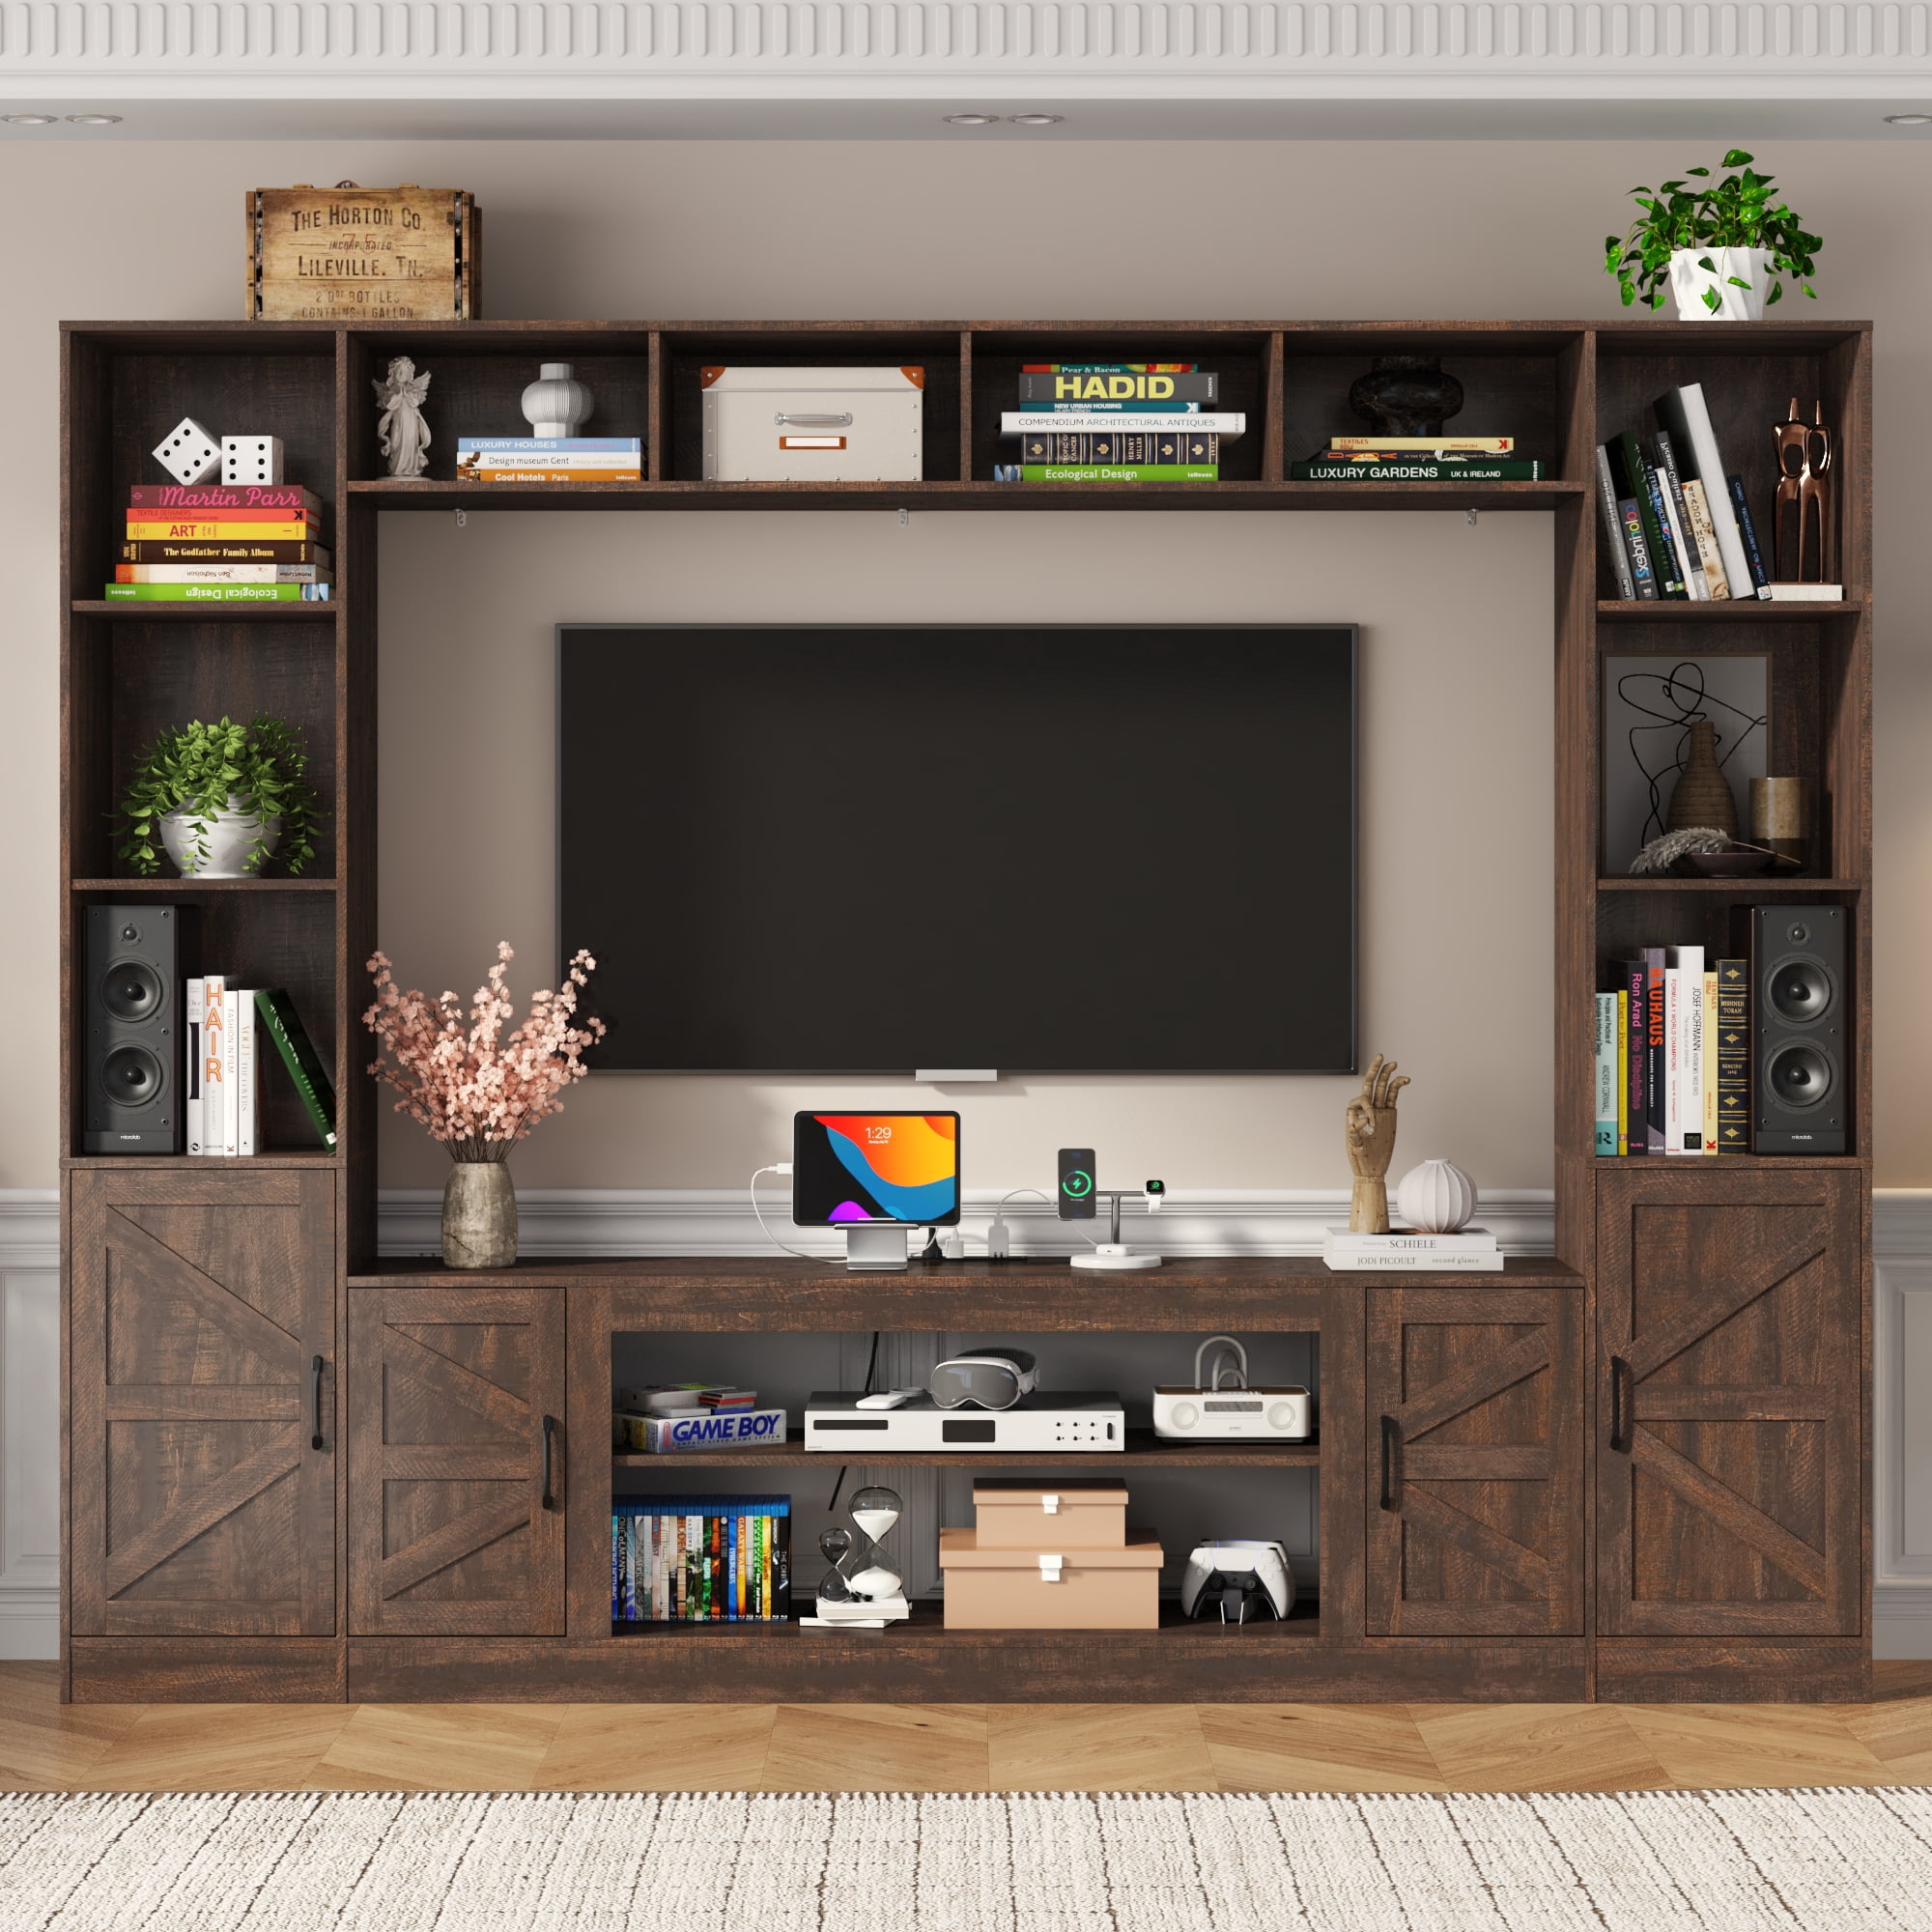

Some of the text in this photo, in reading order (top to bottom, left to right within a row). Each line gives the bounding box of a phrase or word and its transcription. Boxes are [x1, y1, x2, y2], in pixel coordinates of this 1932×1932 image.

[292, 210, 321, 232] THE
[328, 205, 393, 226] HORTON
[349, 291, 400, 303] BOTTLES
[301, 307, 355, 319] CONTAINS
[372, 307, 414, 319] GALLON
[1055, 376, 1175, 399] HADID
[1167, 418, 1215, 427] ANTIQUES
[489, 457, 515, 467] Design
[1045, 469, 1137, 481] Ecological Design
[1310, 468, 1366, 478] LUXURY
[1370, 468, 1437, 478] GARDENS
[161, 486, 241, 507] Martin
[245, 486, 300, 507] Parr
[169, 525, 197, 537] ART
[163, 547, 274, 558] The Godfather Family Album
[185, 588, 278, 600] Ecological Design
[1692, 987, 1701, 1009] JOSEF
[1648, 967, 1664, 1046] BAUHAUS
[205, 983, 222, 1082] HAIR
[1692, 1009, 1701, 1051] HOFFMANN
[1630, 973, 1643, 1110] Ron Arad No Discipline
[1602, 1065, 1610, 1114] ANDREW CORNWALL
[866, 1126, 892, 1139] 1:29
[1389, 1239, 1436, 1249] SCHIELE
[1357, 1257, 1378, 1266] JODI
[1379, 1257, 1417, 1265] PICOULT
[1457, 1257, 1480, 1265] glance
[672, 1417, 735, 1441] GAME
[738, 1414, 781, 1437] BOY
